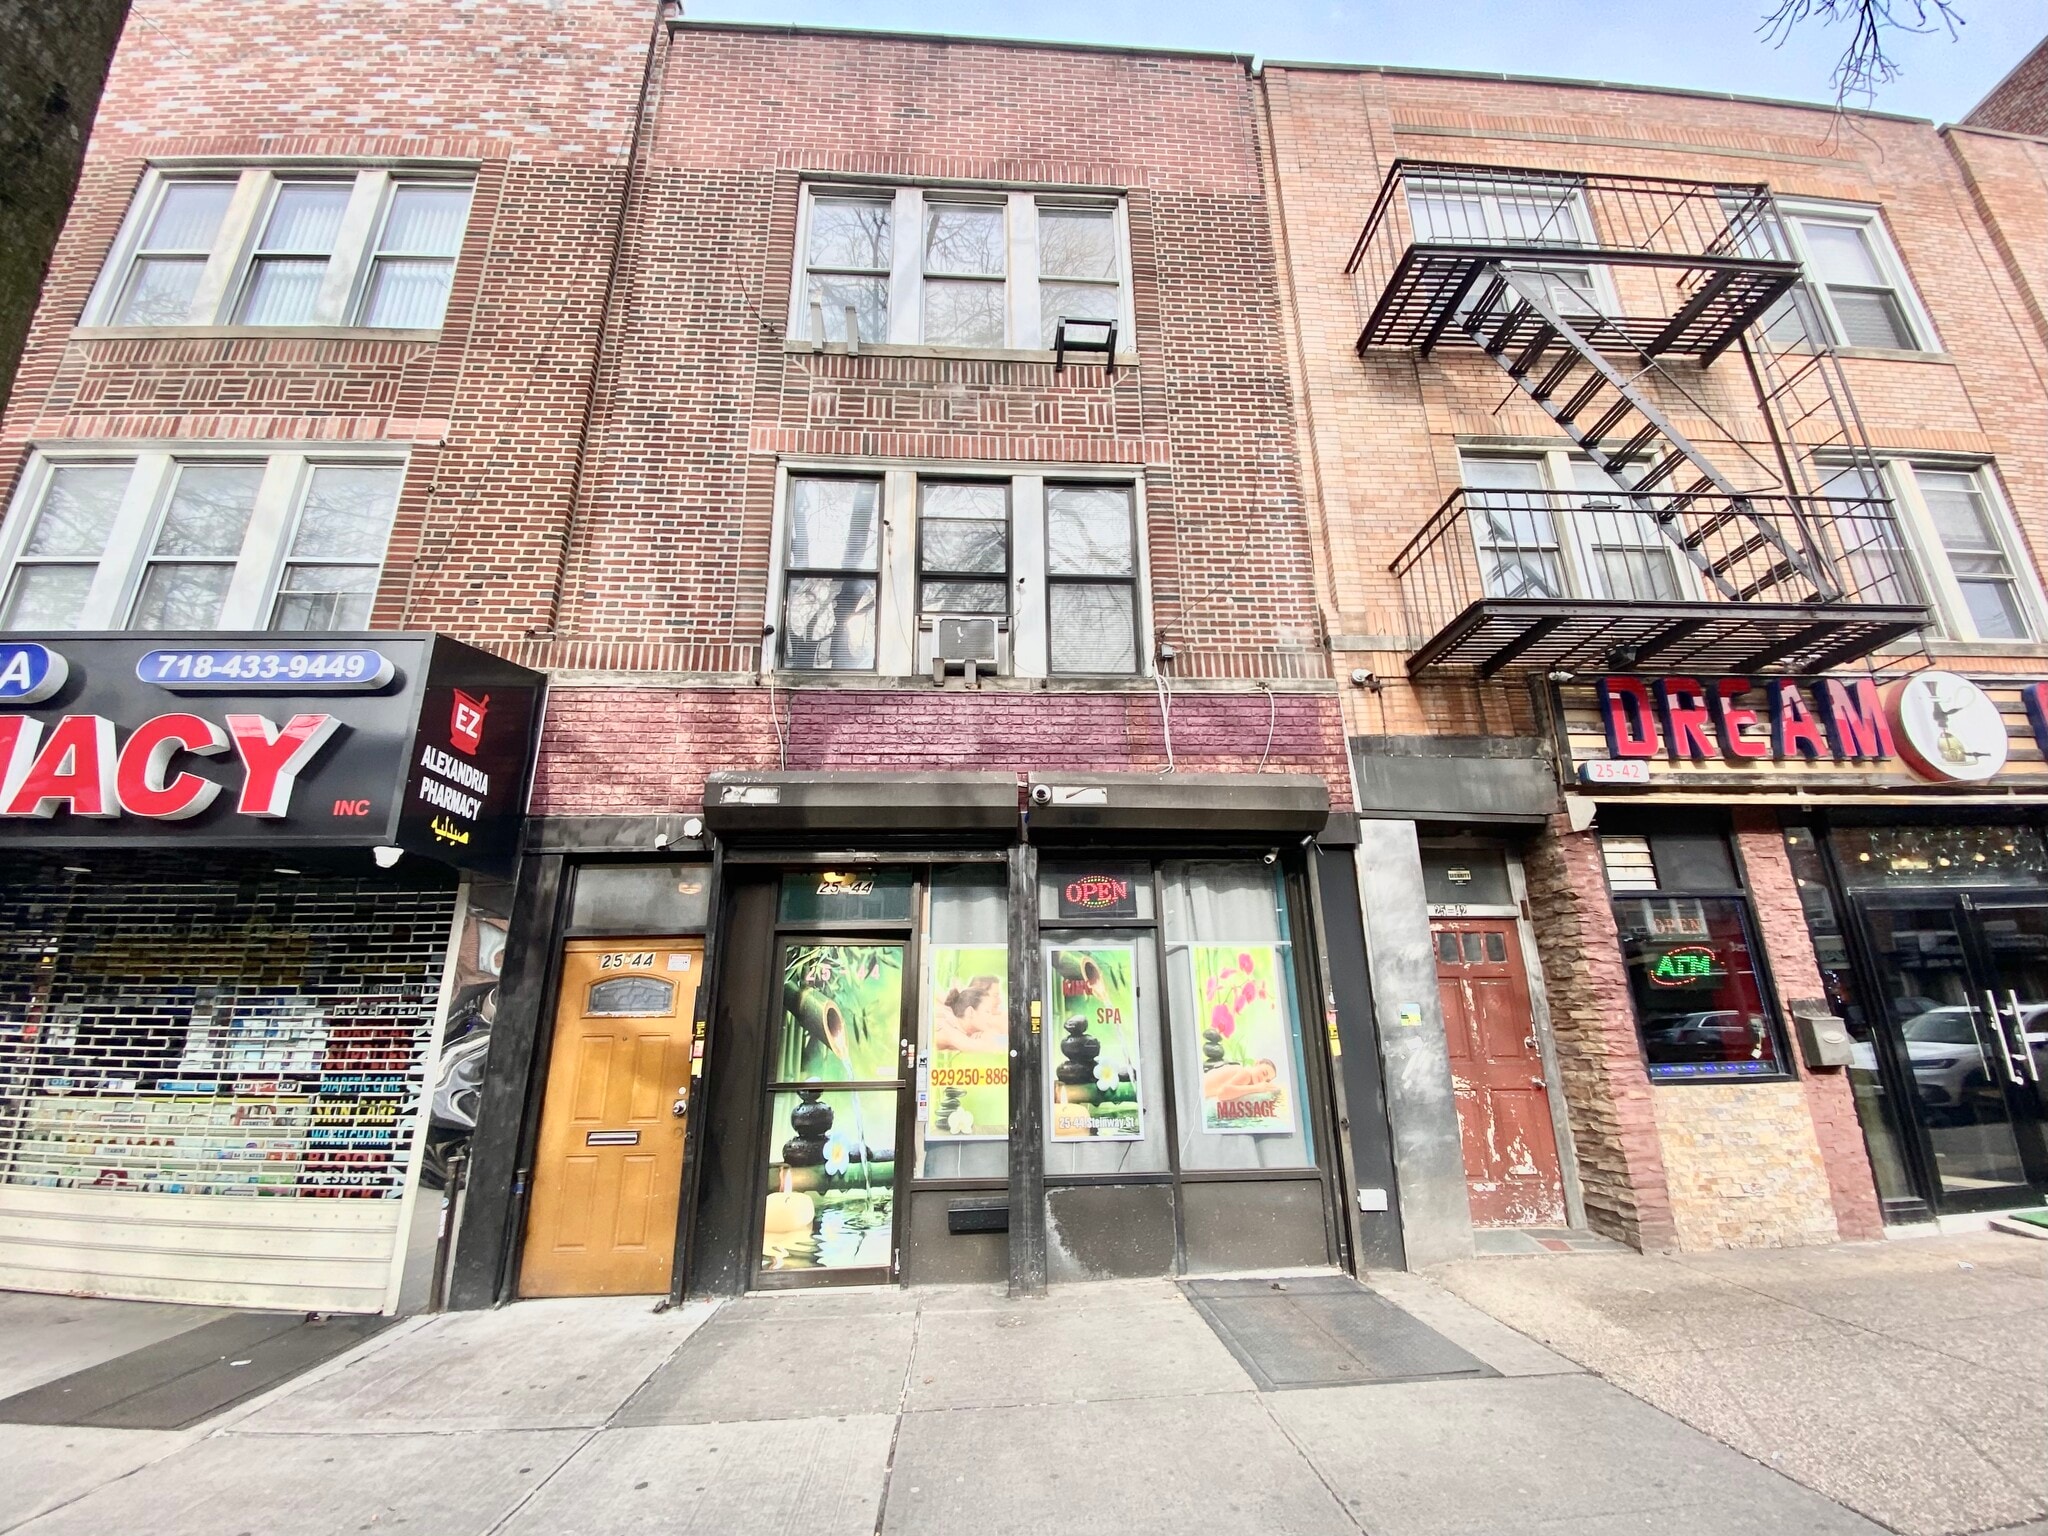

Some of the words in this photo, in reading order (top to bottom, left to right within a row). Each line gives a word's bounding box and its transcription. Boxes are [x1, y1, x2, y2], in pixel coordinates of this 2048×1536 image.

[157, 655, 365, 679] 718-433-9449
[455, 702, 481, 739] EZ
[1598, 675, 1897, 758] DREAM
[0, 713, 332, 818] ACY
[420, 745, 489, 796] ALEXANDRIA
[1595, 763, 1641, 778] 25-42
[333, 800, 371, 816] INC
[419, 776, 482, 821] PHARMACY
[1065, 881, 1128, 903] OPEN
[1653, 918, 1702, 935] OPEN
[1656, 955, 1711, 977] ATM
[1096, 1007, 1122, 1024] SPA
[332, 1024, 409, 1038] SURGCAL
[320, 1076, 370, 1092] DIABETIC
[1216, 1100, 1277, 1119] MASSAGE
